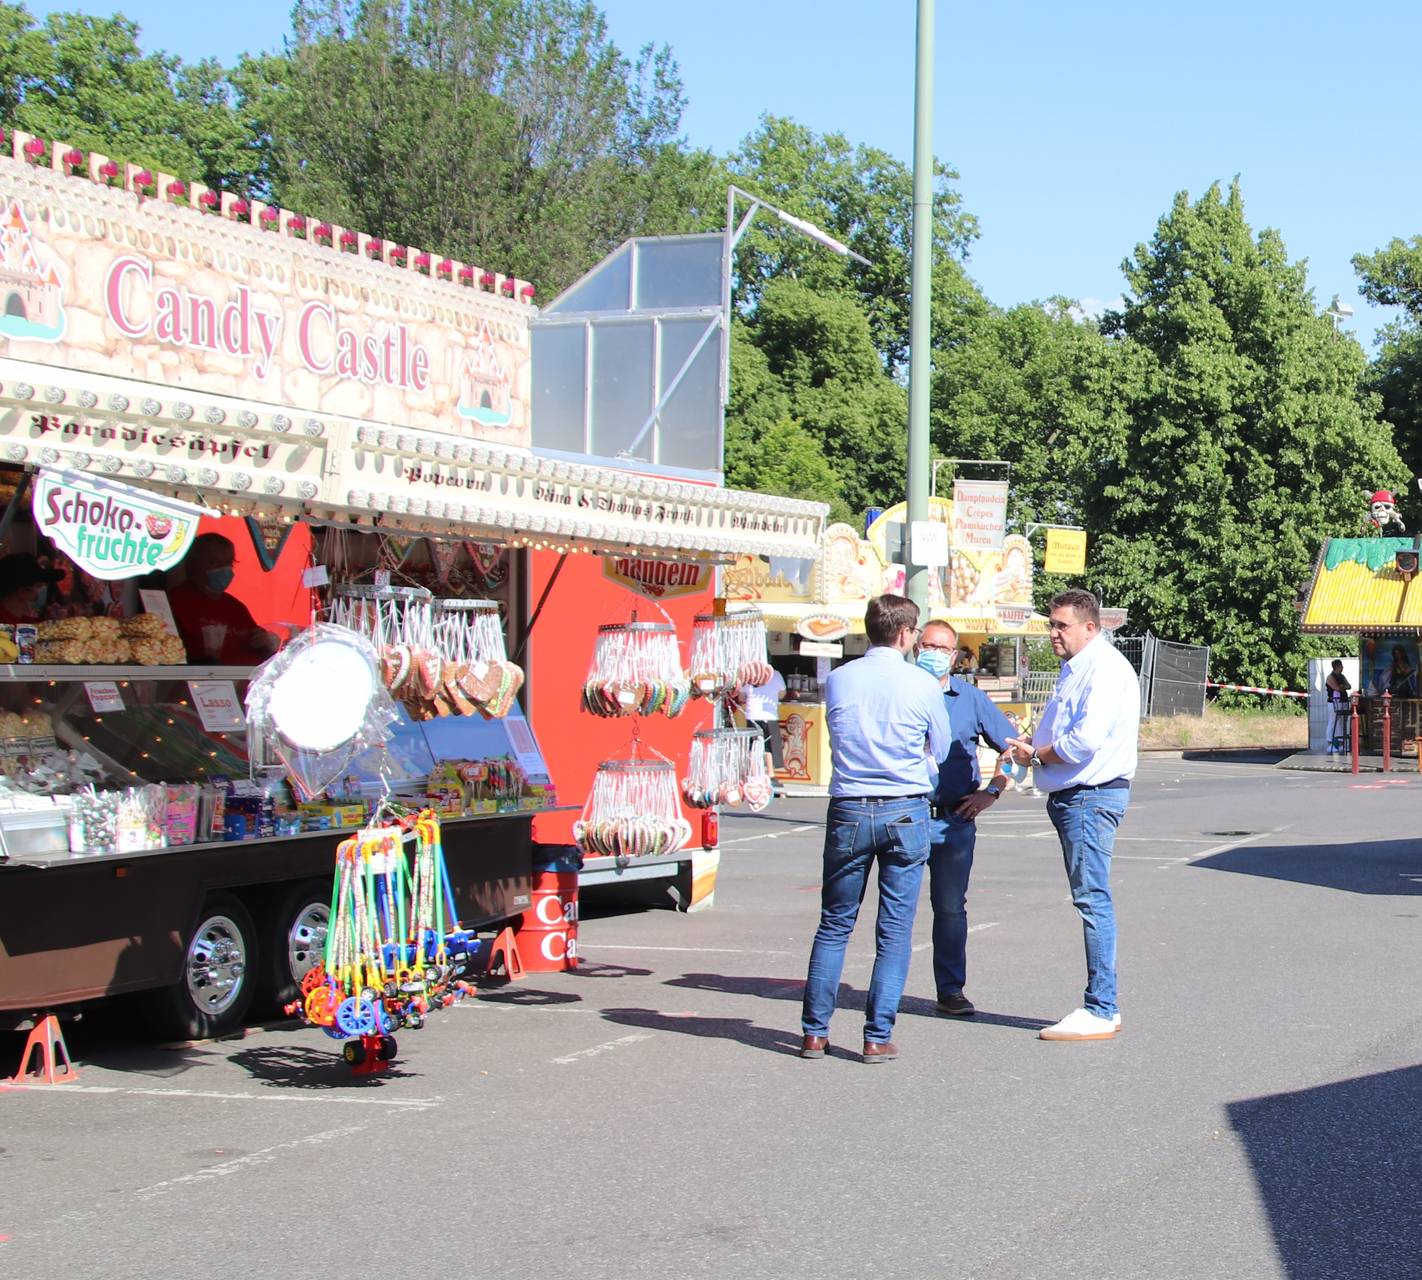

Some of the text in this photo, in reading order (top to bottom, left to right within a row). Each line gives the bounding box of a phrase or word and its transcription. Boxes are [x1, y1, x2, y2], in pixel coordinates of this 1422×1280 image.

[106, 257, 430, 391] Candy Castle
[31, 415, 273, 460] Paradiesäpfel
[404, 466, 486, 491] Popcorn
[44, 487, 143, 534] Schoko-
[76, 525, 164, 566] früchte
